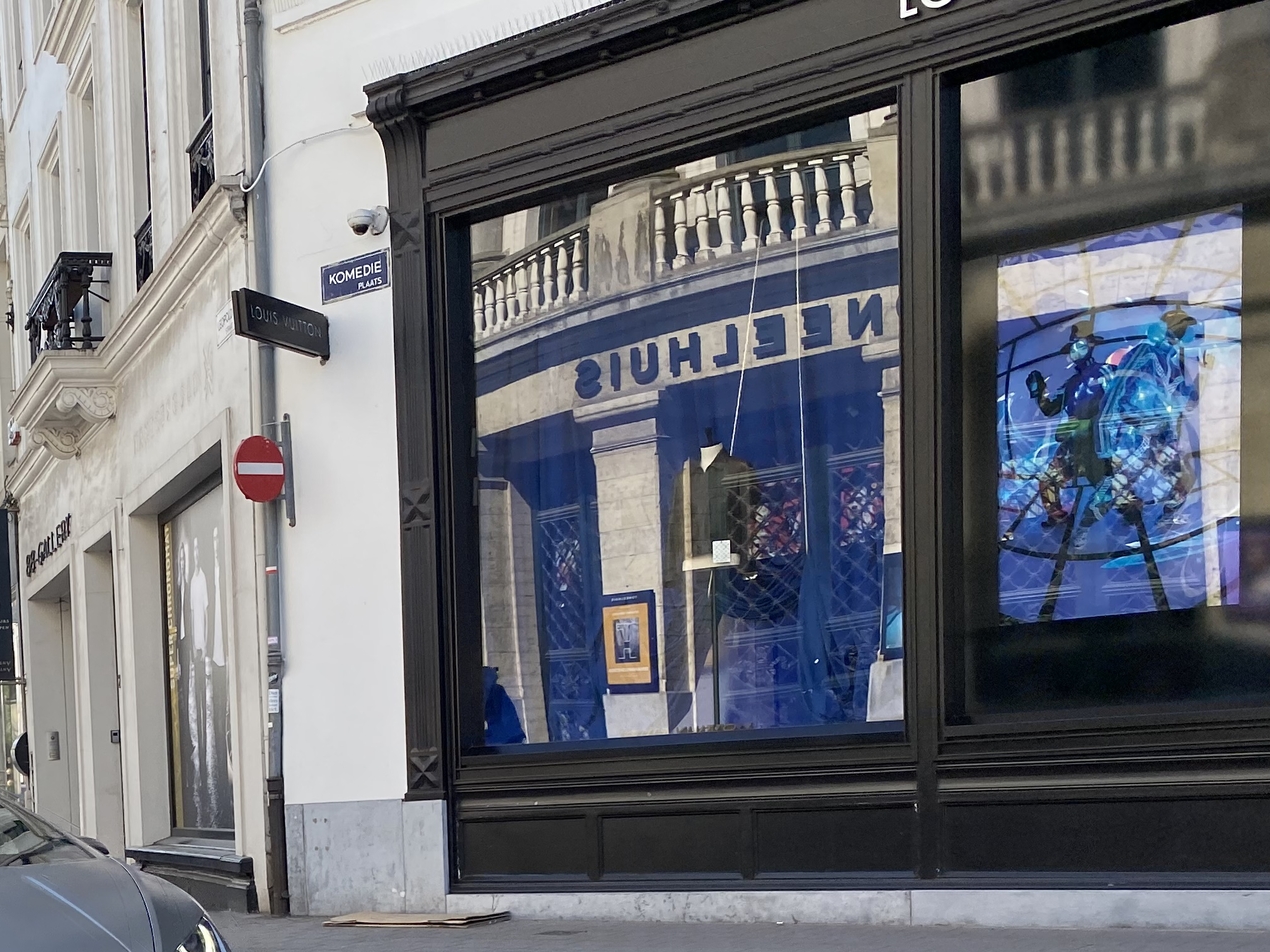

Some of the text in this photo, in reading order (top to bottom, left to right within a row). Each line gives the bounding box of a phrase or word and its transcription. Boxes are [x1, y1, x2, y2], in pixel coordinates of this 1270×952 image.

[329, 260, 382, 285] KOMEDIE
[358, 277, 383, 290] PLAATS
[250, 305, 322, 338] LOUIS VUITTON
